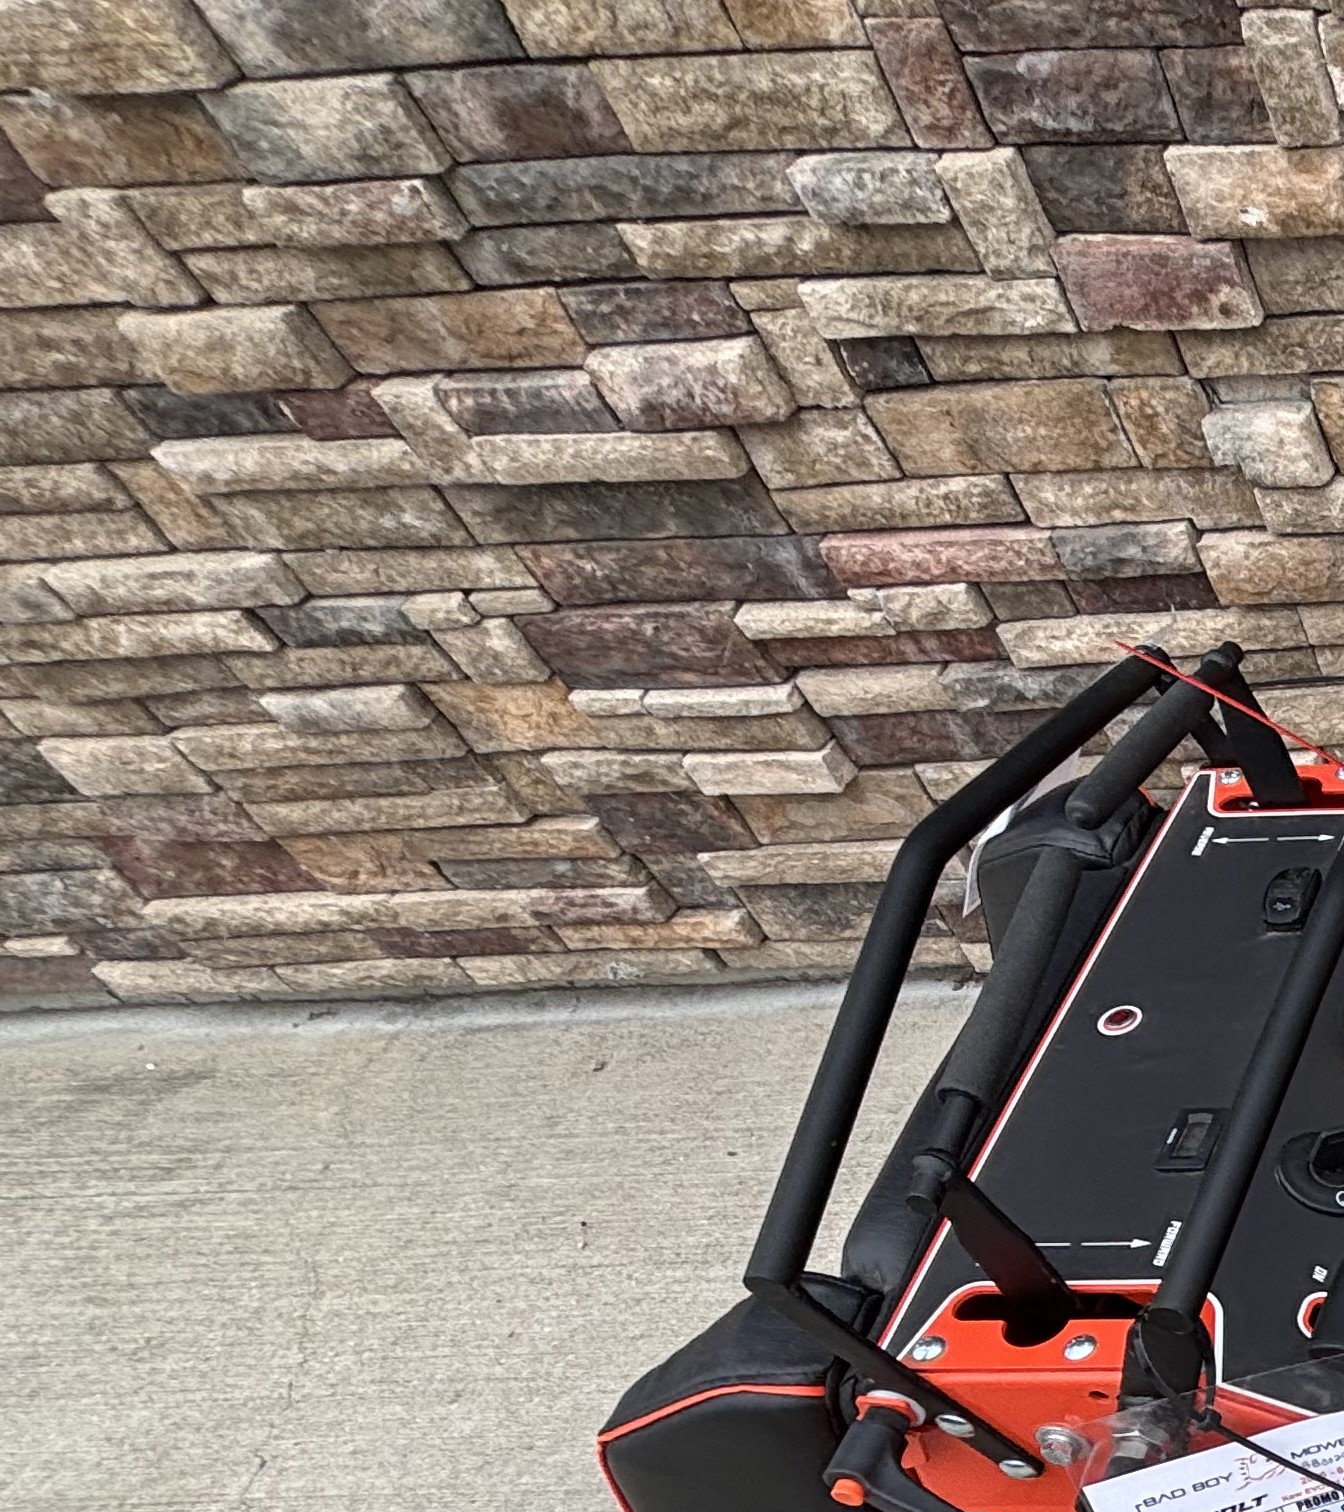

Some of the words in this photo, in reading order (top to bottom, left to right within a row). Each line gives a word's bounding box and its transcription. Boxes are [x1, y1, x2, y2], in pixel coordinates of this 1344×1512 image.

[1152, 1220, 1183, 1267] FORWARD
[1312, 1265, 1328, 1283] ON
[1142, 1488, 1187, 1507] BAD
[1192, 1472, 1233, 1492] BOY
[1295, 1490, 1340, 1512] PROMO
